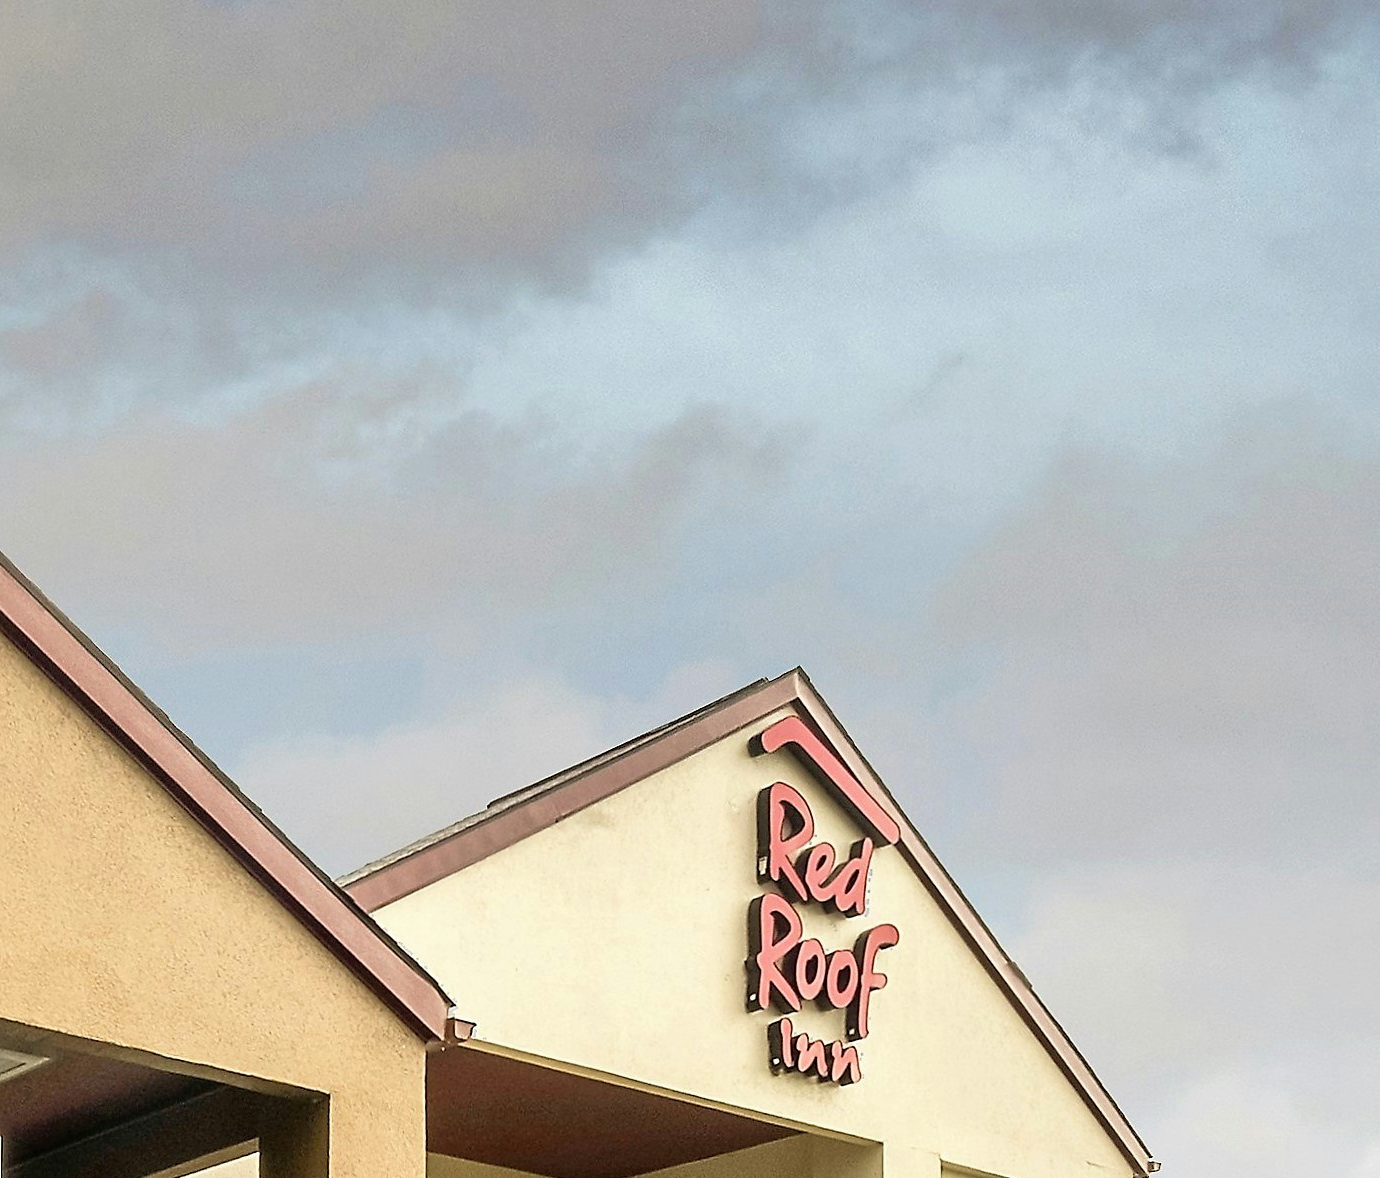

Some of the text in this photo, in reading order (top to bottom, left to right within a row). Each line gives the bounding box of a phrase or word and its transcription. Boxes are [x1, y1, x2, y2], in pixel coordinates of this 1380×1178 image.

[757, 782, 873, 918] Red
[746, 893, 899, 1041] Roof
[768, 1017, 861, 1086] Inn
